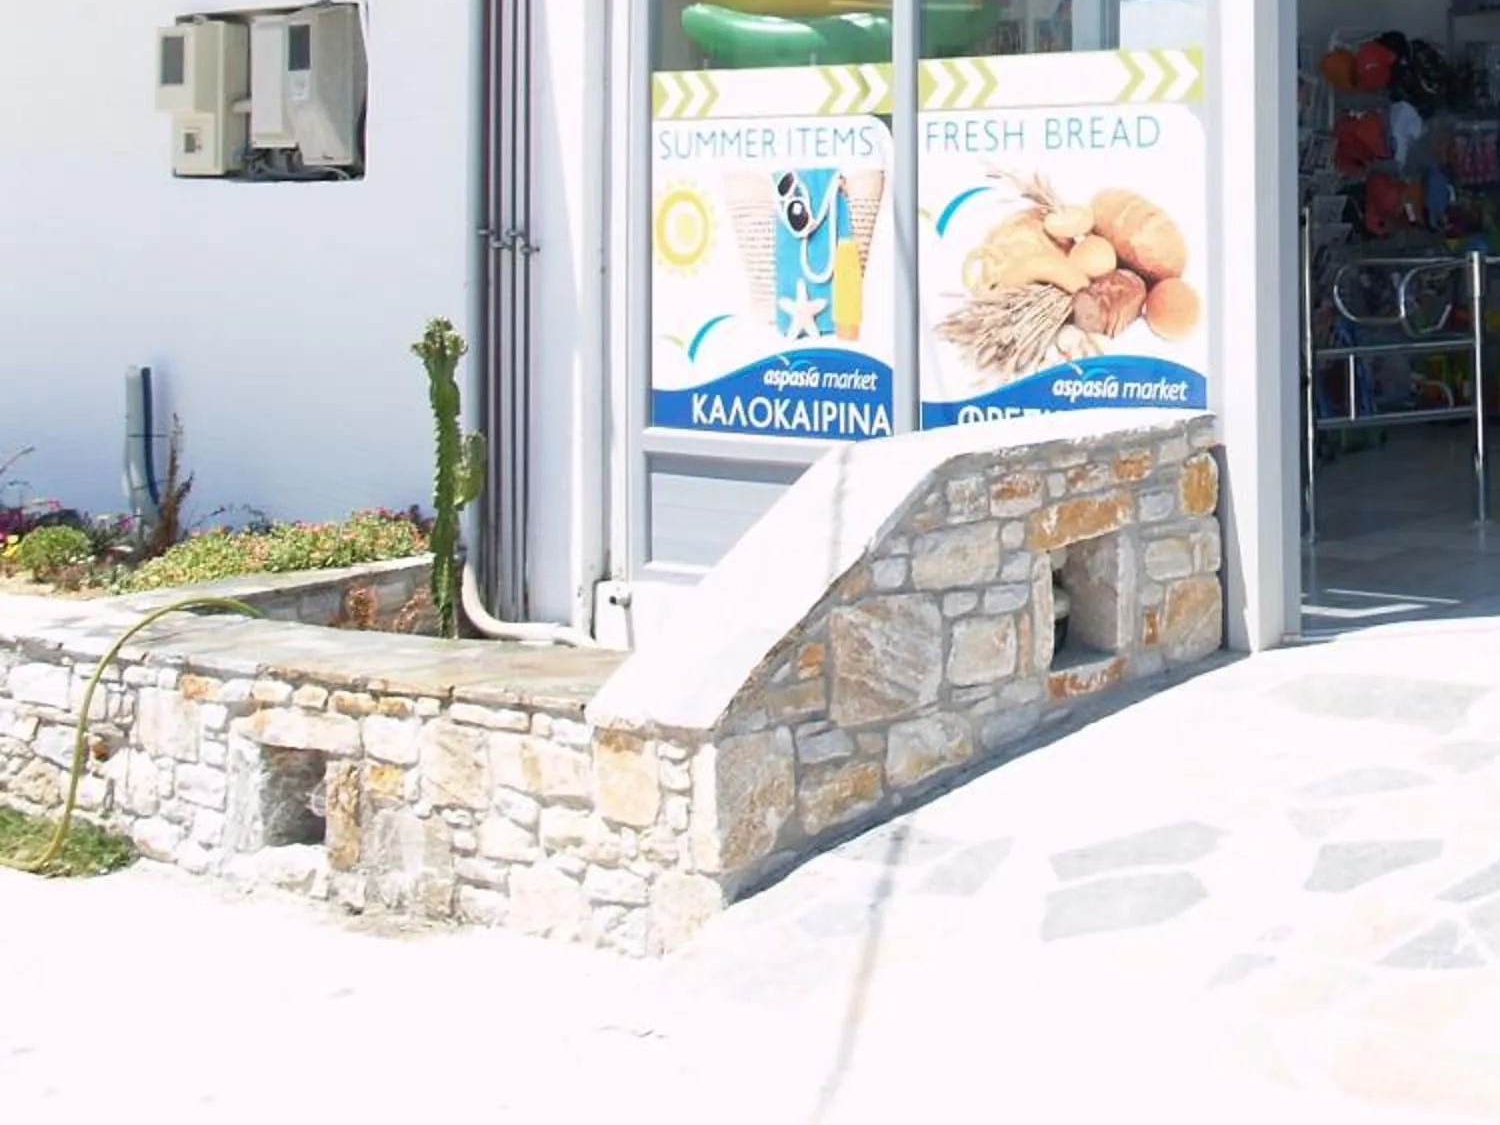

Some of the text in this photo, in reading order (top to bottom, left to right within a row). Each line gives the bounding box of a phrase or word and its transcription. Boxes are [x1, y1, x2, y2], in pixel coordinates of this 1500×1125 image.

[658, 125, 874, 161] SUMMER ITEMS
[926, 115, 1161, 154] FRESH BREAD
[822, 368, 878, 391] market
[1122, 377, 1188, 402] market
[691, 392, 893, 436] ΚΑΛΟΚΑΙΡΙΝΑ
